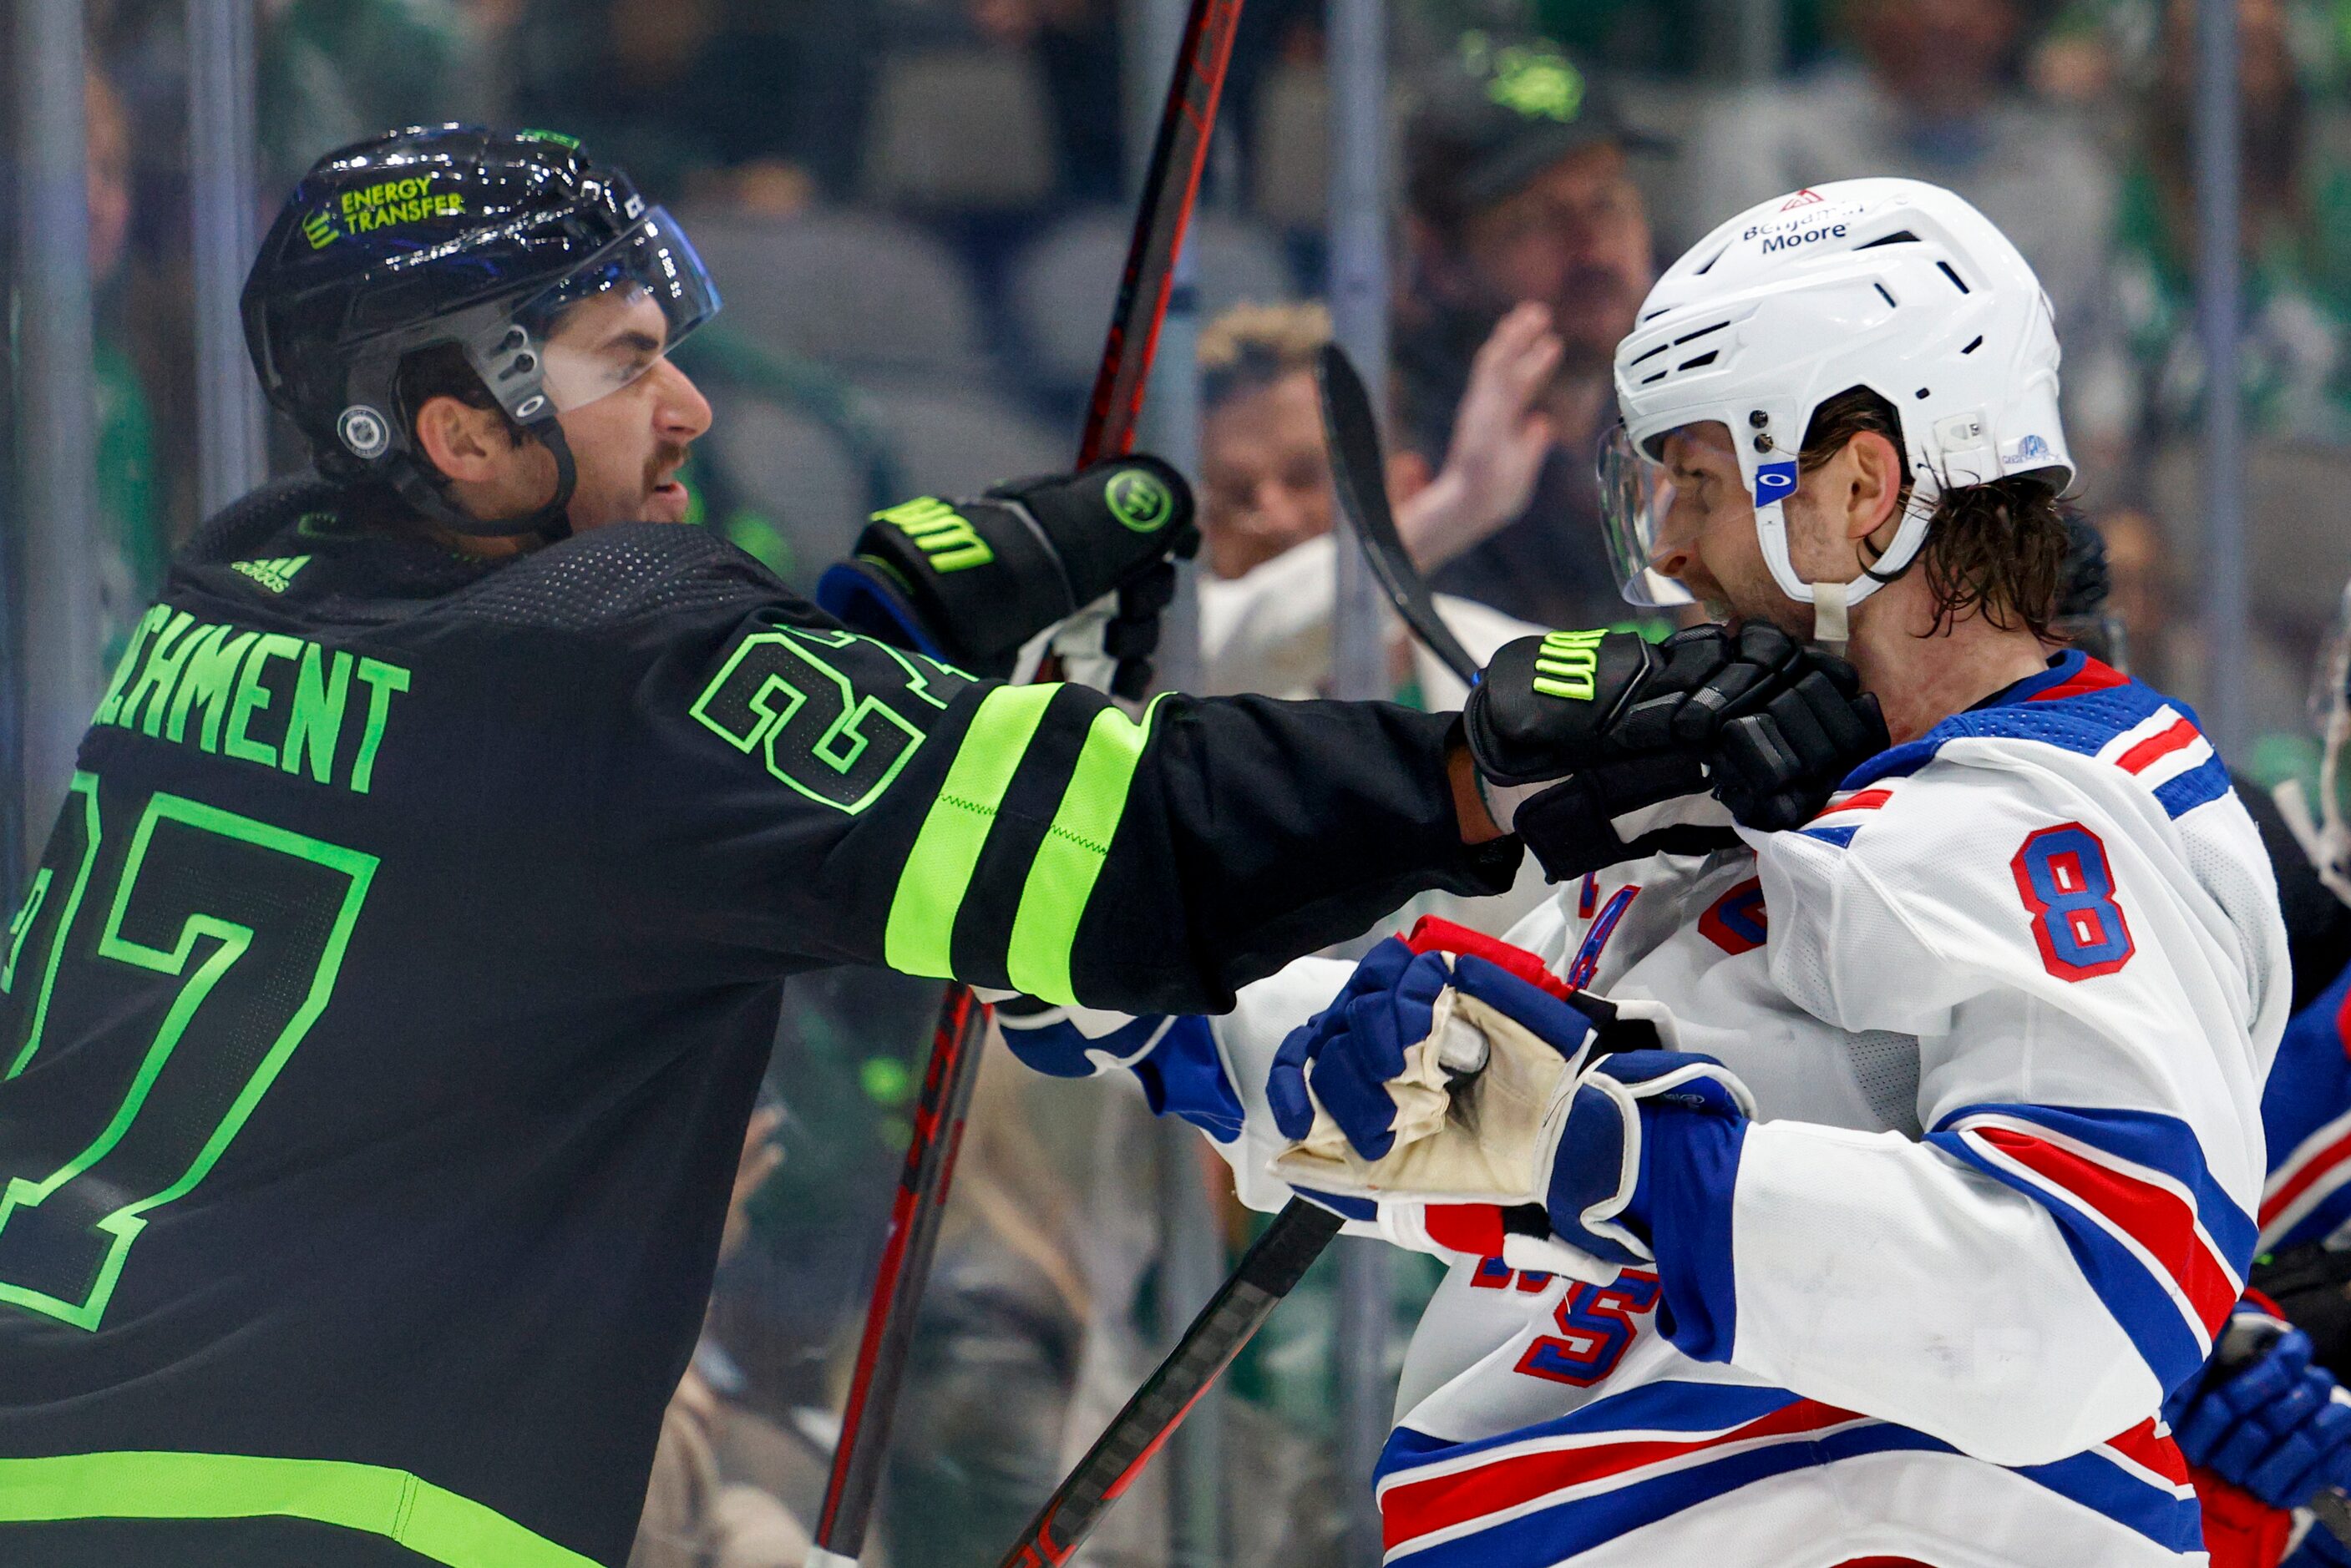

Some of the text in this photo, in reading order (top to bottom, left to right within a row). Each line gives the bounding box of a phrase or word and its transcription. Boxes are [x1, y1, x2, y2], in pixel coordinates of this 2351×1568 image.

[341, 176, 433, 214] ENERGY
[344, 192, 467, 235] TRANSFER
[1743, 202, 1864, 241] Bejam
[1762, 224, 1847, 254] Moore
[89, 603, 411, 794] CHMENT
[2009, 821, 2136, 984] 8
